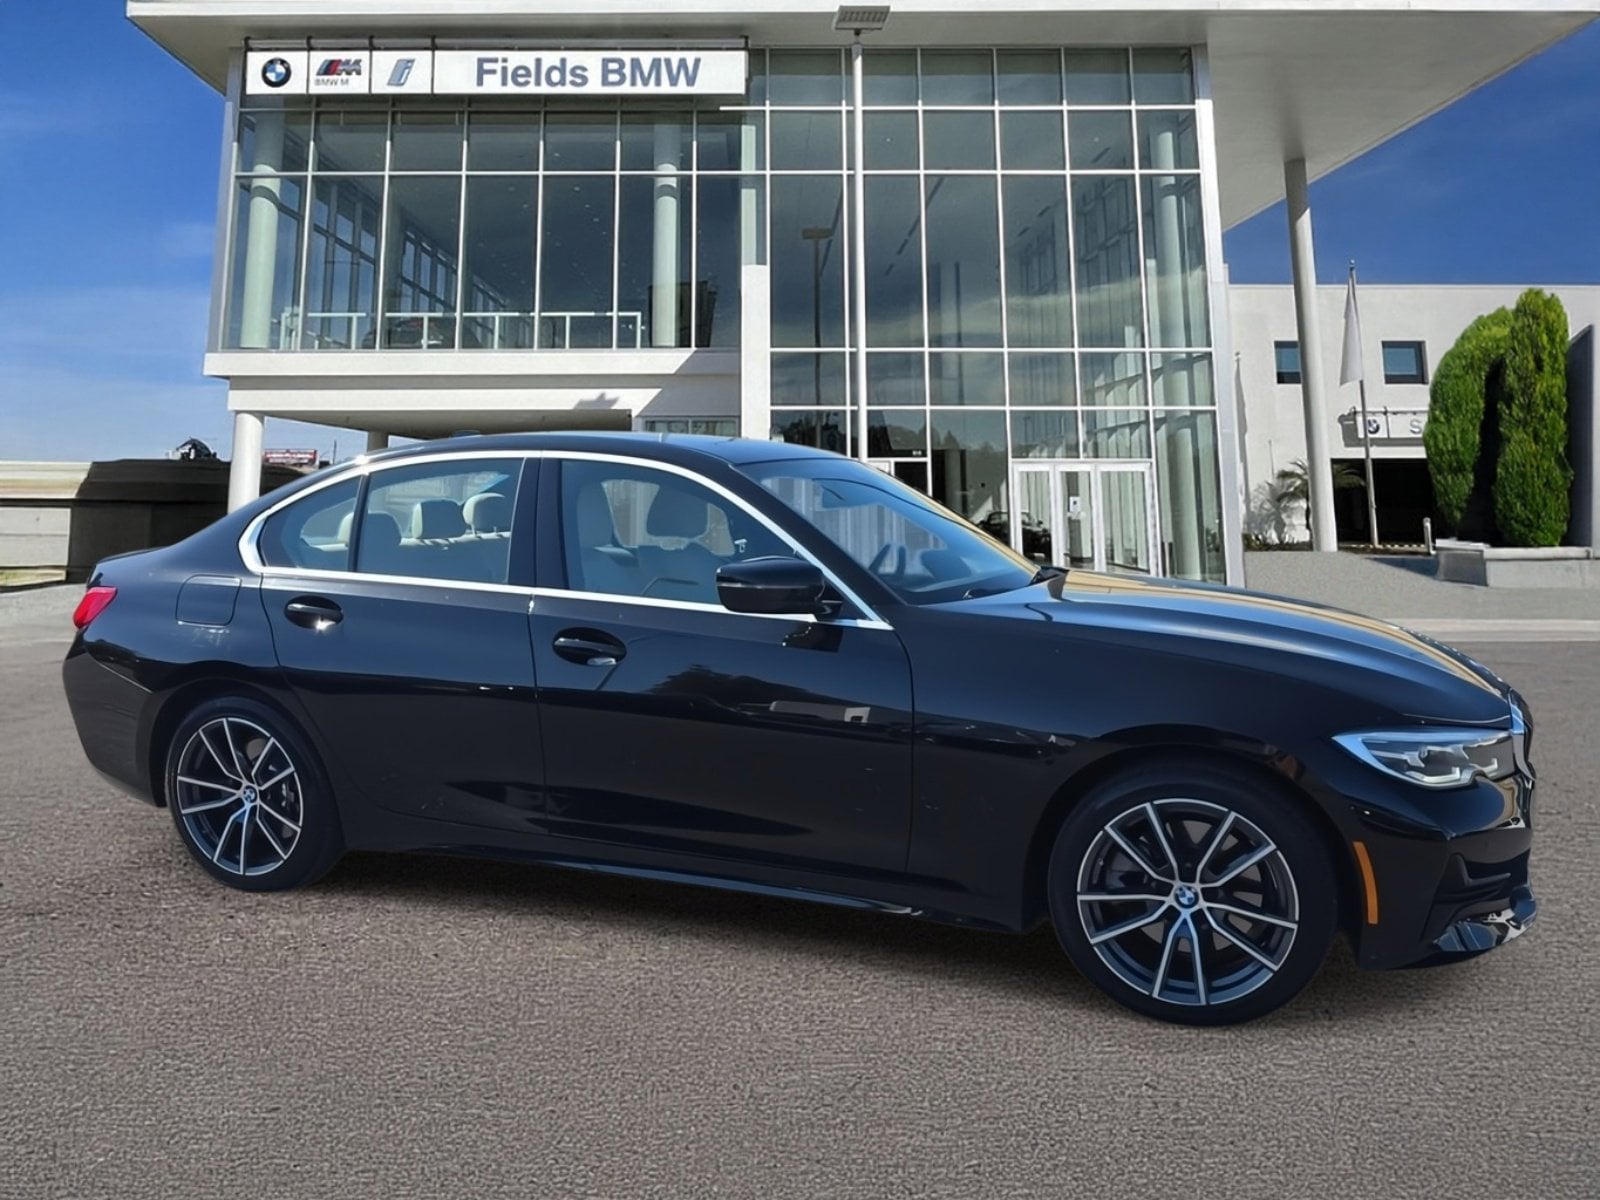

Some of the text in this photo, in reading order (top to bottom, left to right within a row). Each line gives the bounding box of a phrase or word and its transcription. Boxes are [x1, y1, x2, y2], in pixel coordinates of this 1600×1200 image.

[476, 57, 702, 87] Fields BMW
[314, 78, 338, 86] BMW
